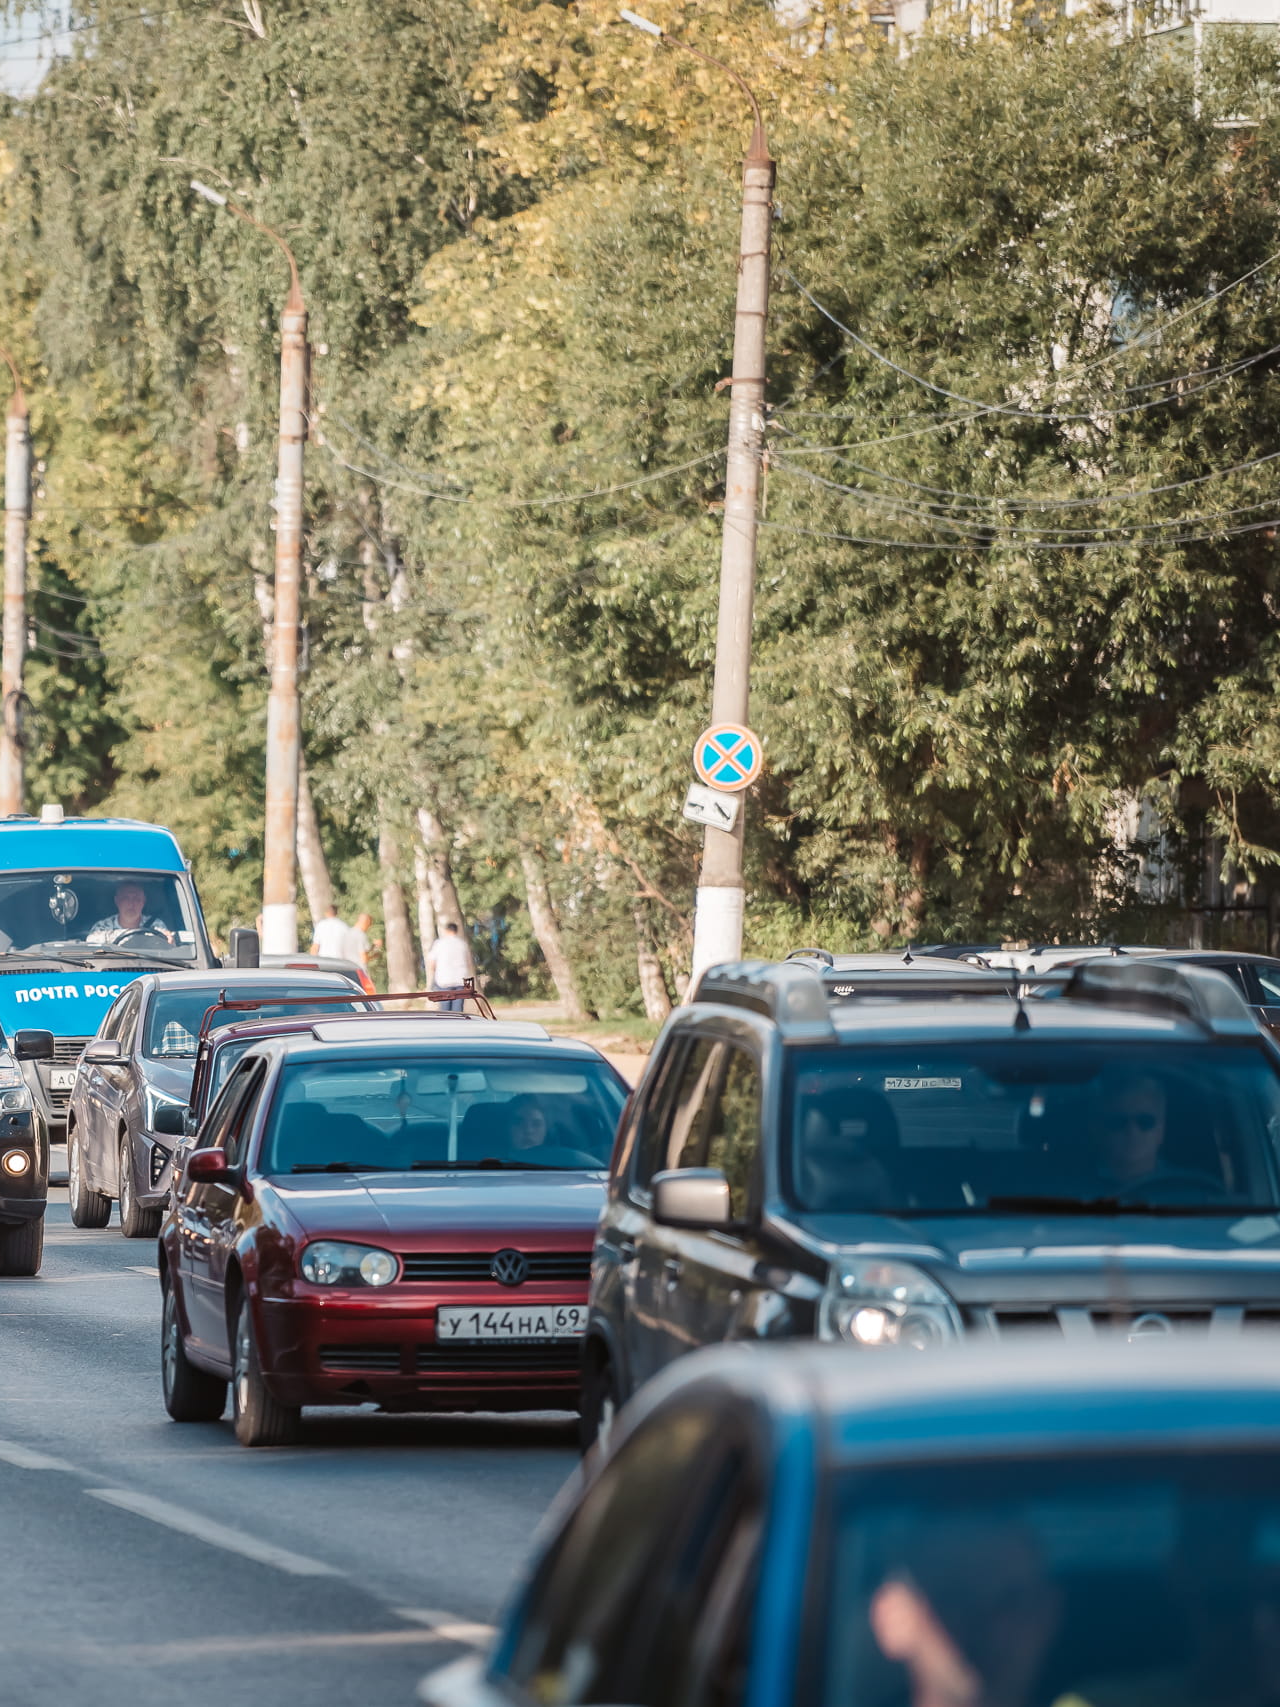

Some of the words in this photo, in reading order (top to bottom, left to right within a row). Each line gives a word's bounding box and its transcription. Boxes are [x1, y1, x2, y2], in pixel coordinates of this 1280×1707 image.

[15, 985, 79, 1003] ПОЧТА
[84, 985, 127, 998] РОС
[449, 1312, 548, 1335] У144НА
[555, 1309, 580, 1327] 69
